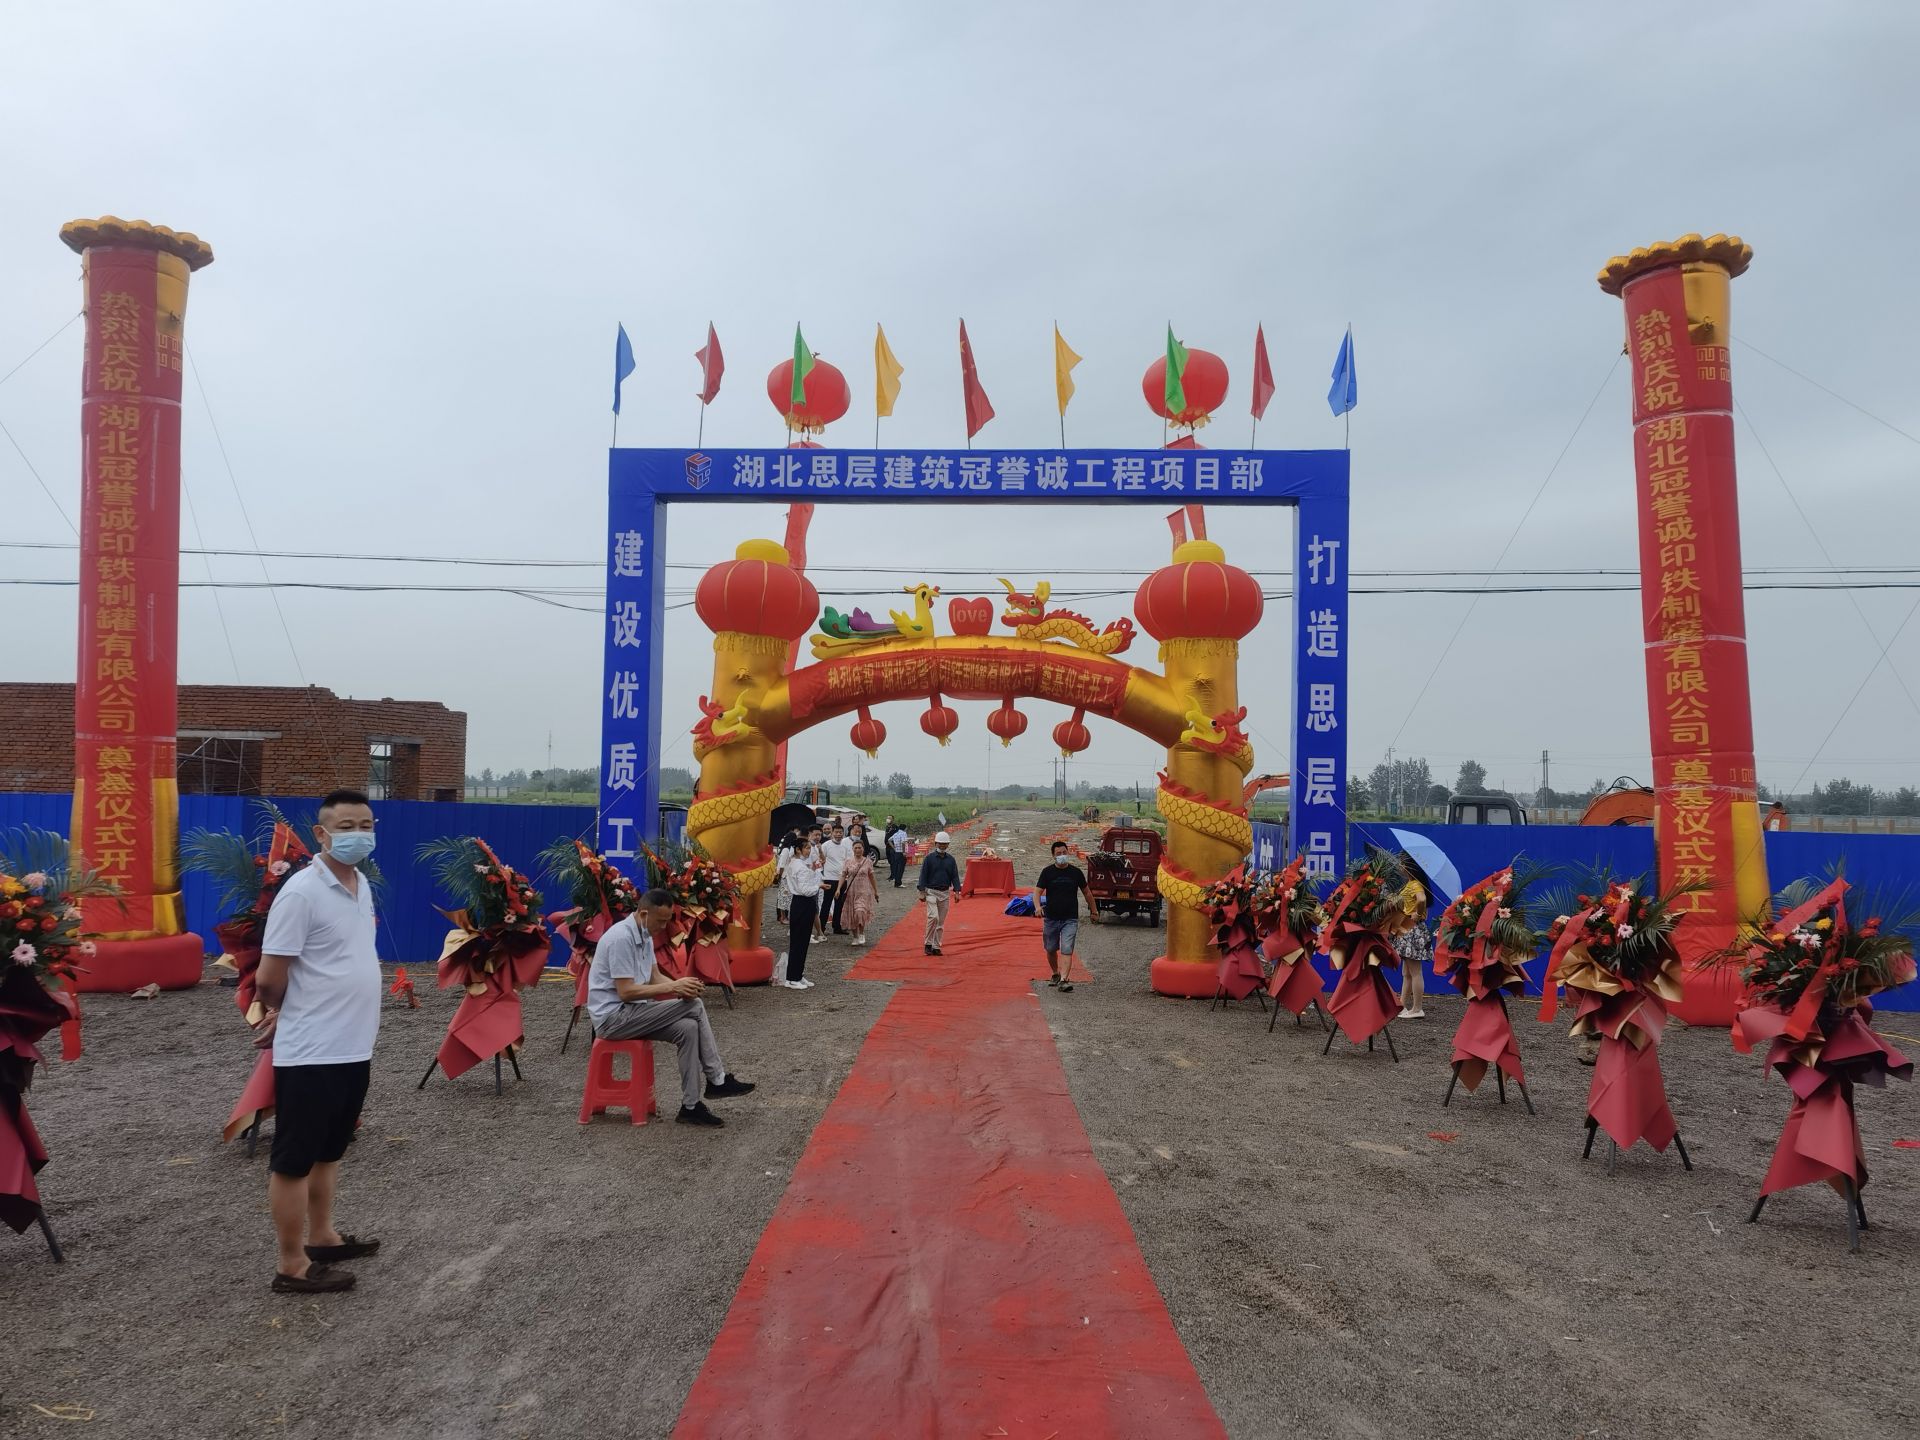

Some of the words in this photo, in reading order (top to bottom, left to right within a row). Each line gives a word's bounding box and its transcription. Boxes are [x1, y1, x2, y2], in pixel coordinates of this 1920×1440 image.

[732, 455, 1264, 492] 湖北思层建筑冠誉诚工程项目部
[952, 604, 987, 623] love
